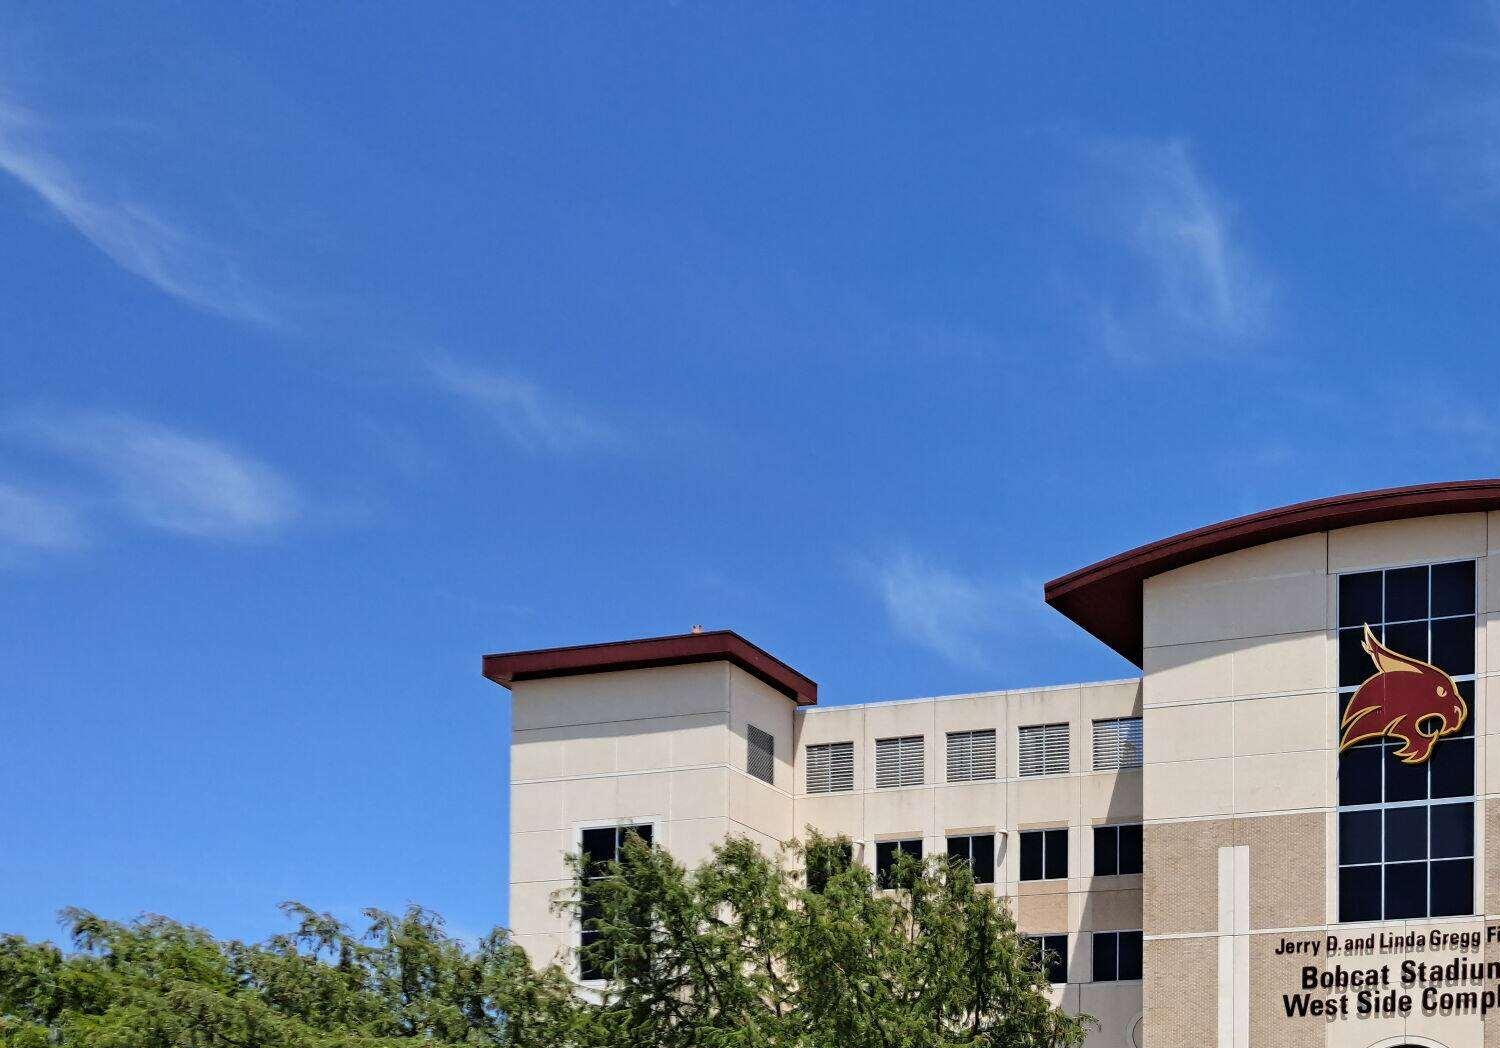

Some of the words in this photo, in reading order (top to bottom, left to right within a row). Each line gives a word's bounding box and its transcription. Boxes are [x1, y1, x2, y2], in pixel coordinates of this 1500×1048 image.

[1275, 938, 1320, 955] Jerry
[1326, 935, 1342, 951] D.
[1345, 933, 1375, 950] and
[1380, 931, 1425, 948] Linda
[1430, 929, 1481, 948] Gregg
[1302, 964, 1390, 990] Bobcat
[1283, 993, 1349, 1018] West
[1357, 989, 1412, 1014] Side
